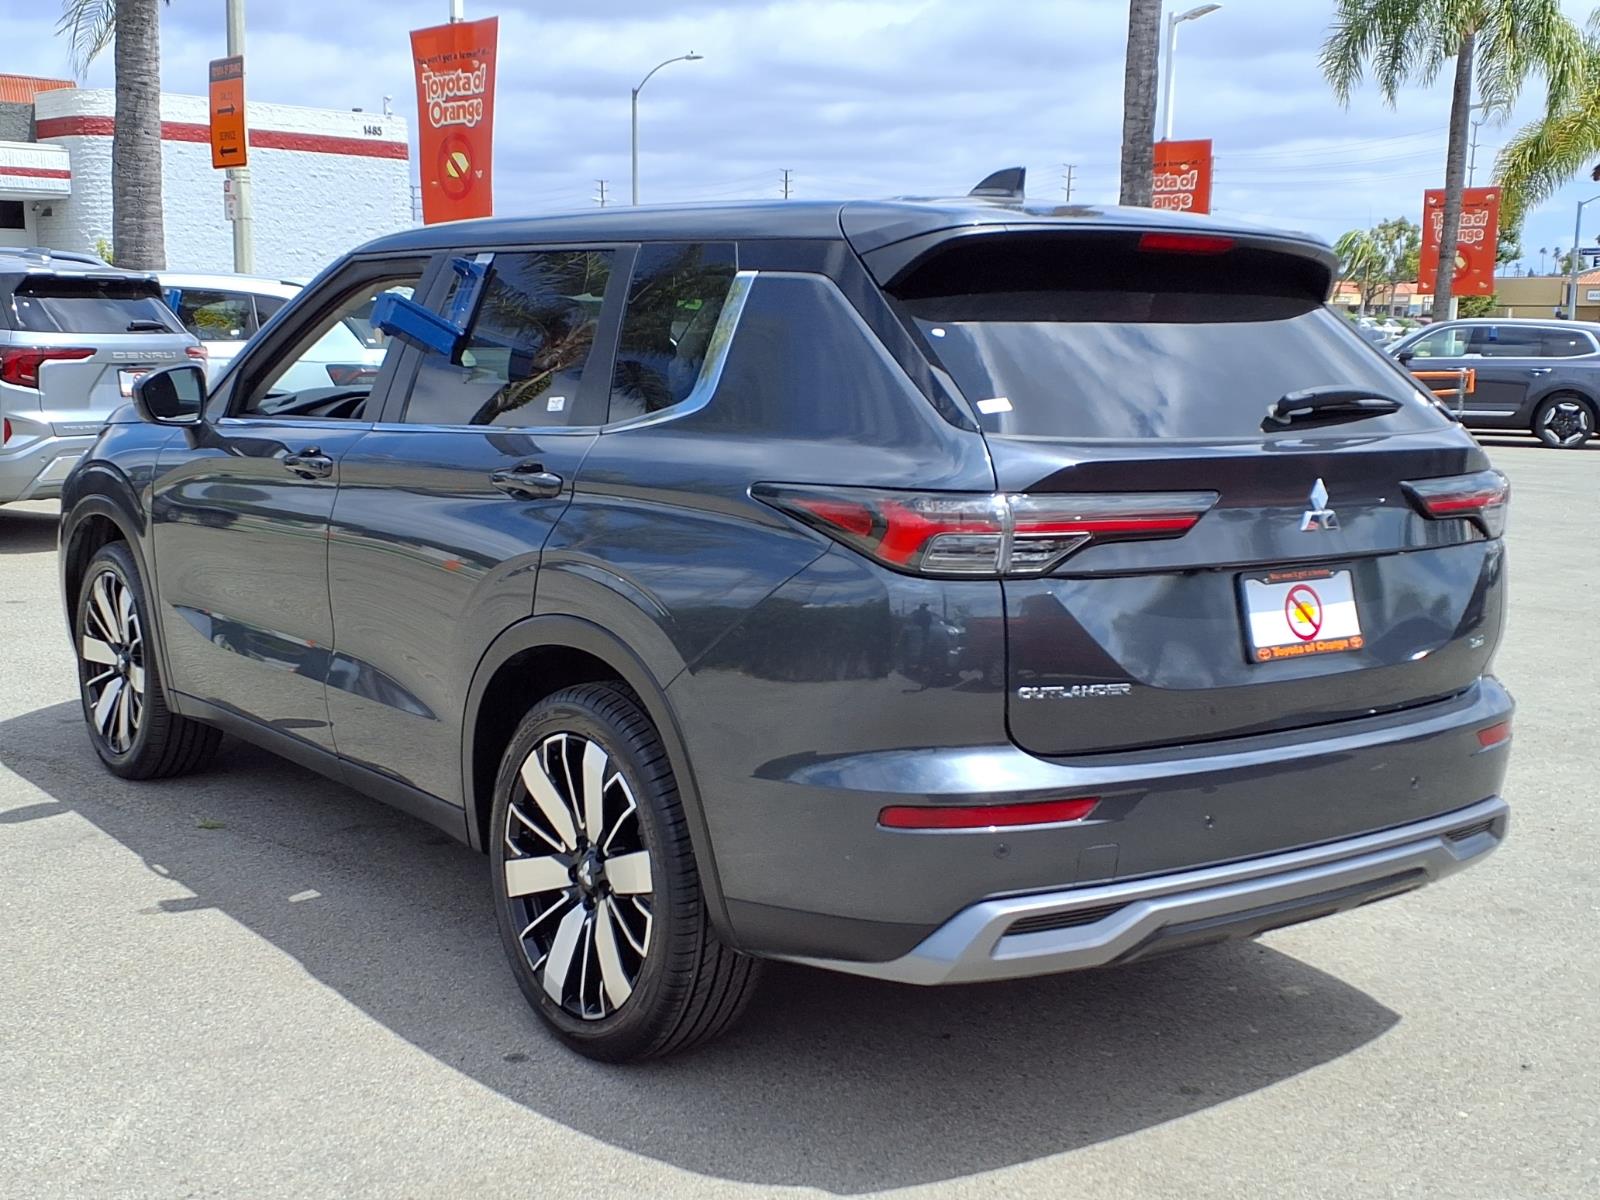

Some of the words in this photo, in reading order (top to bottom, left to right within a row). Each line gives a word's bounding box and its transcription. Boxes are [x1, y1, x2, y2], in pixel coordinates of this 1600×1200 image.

[422, 68, 473, 103] Toyota
[472, 63, 487, 93] of
[429, 98, 483, 128] Orange
[363, 125, 383, 136] 1485
[1152, 172, 1180, 192] ota
[1180, 170, 1198, 191] of
[1152, 193, 1193, 212] ange
[1431, 211, 1473, 230] Tta
[1473, 210, 1489, 226] of
[1435, 228, 1484, 244] Onge
[112, 351, 177, 359] DENALI
[1018, 683, 1132, 700] OUTLANDER
